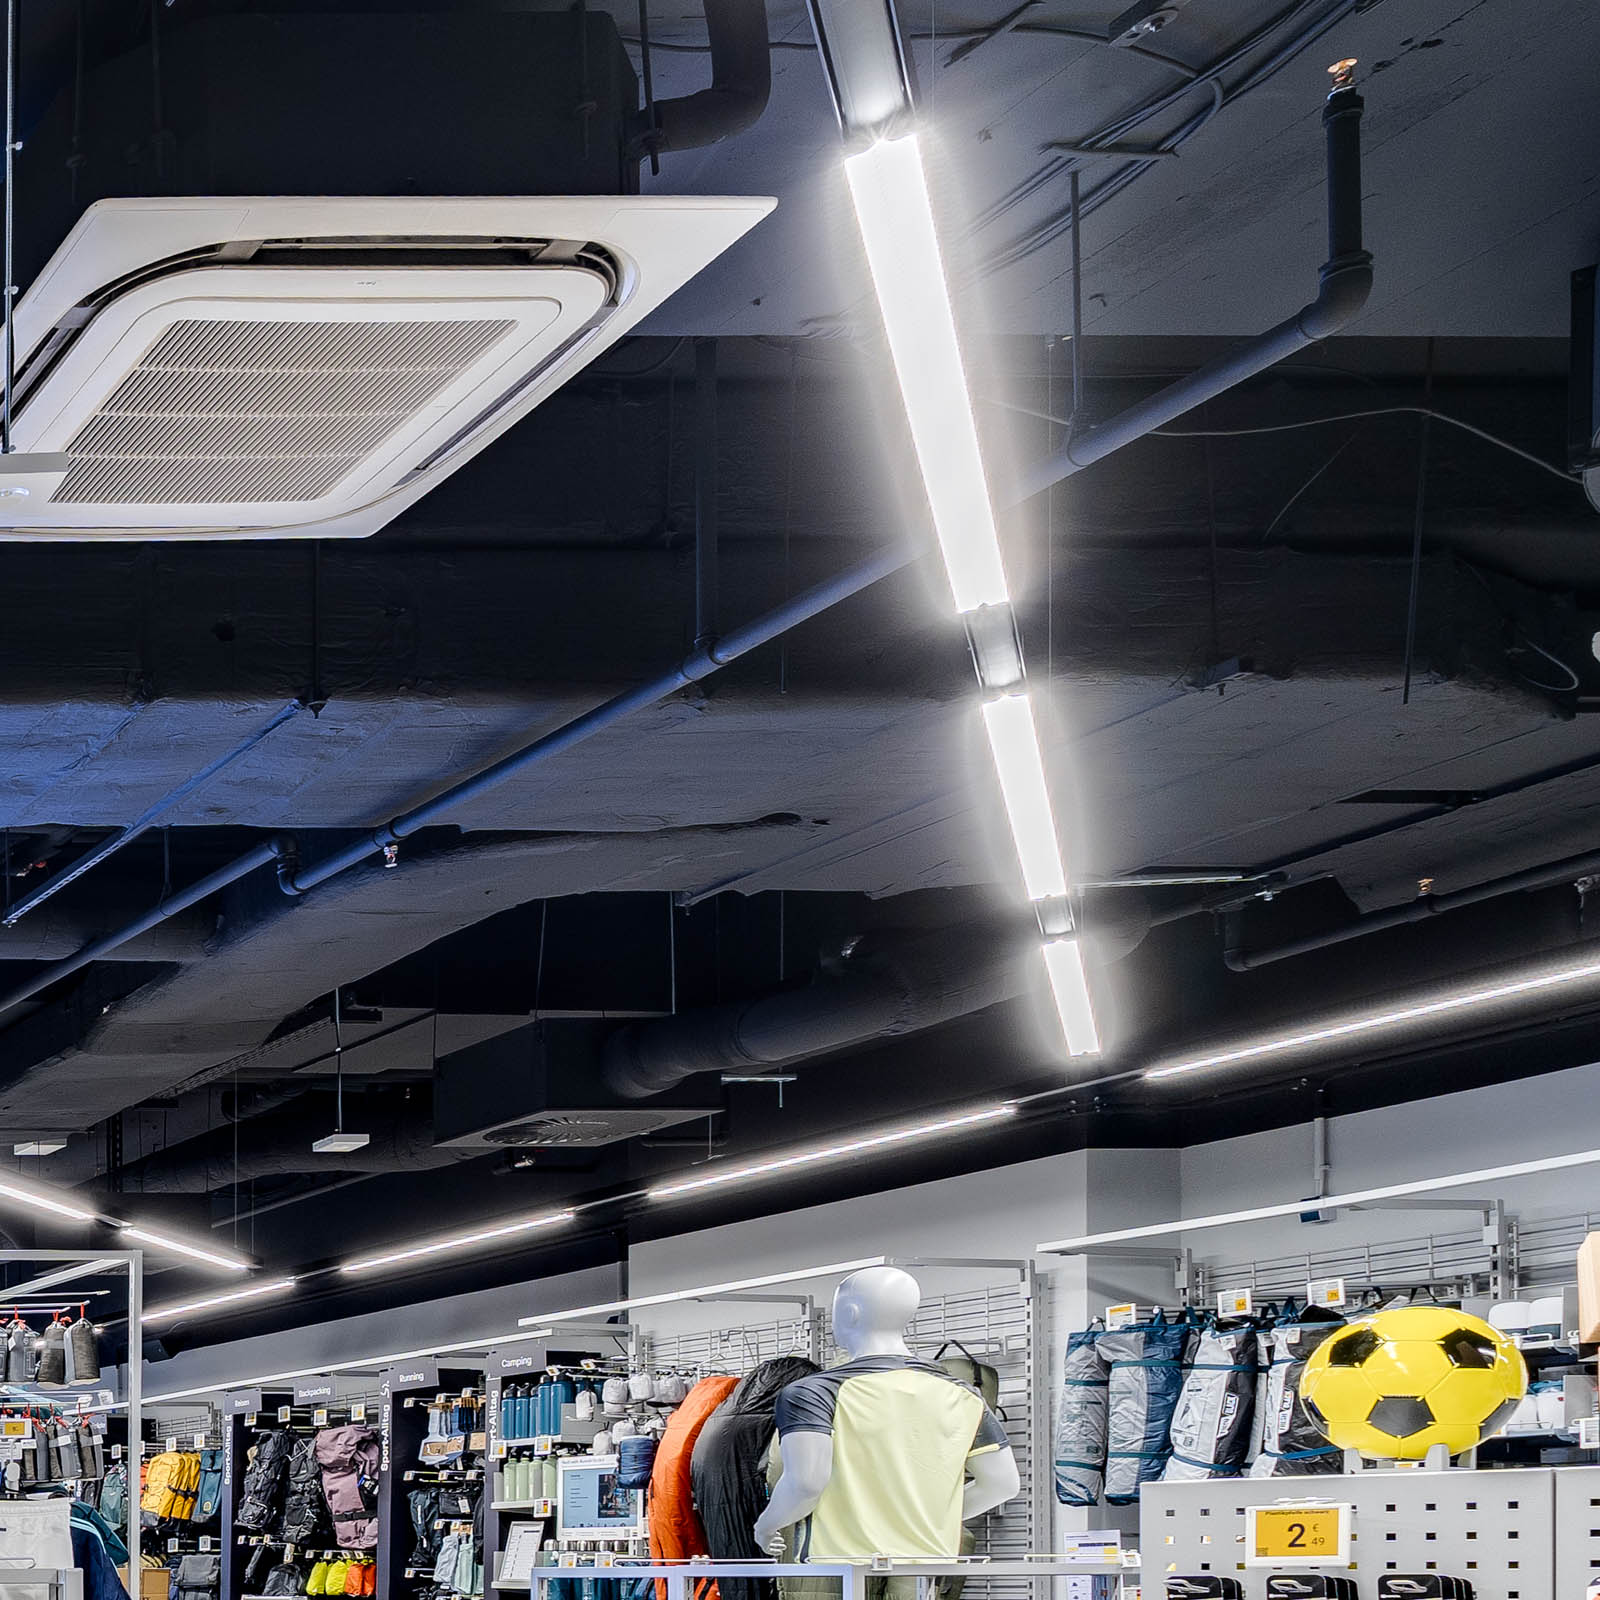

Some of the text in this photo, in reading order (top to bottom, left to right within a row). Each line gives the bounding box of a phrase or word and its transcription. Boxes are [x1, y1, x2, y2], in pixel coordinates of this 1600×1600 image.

[501, 1357, 532, 1370] Camping
[400, 1372, 425, 1383] Running
[299, 1387, 331, 1398] Backpacking
[488, 1390, 499, 1463] Srt-Alltag
[381, 1405, 391, 1472] Sport-Alltag
[224, 1426, 233, 1485] Sport-Alltag
[1287, 1523, 1320, 1547] 2 €
[1311, 1537, 1325, 1545] 49
